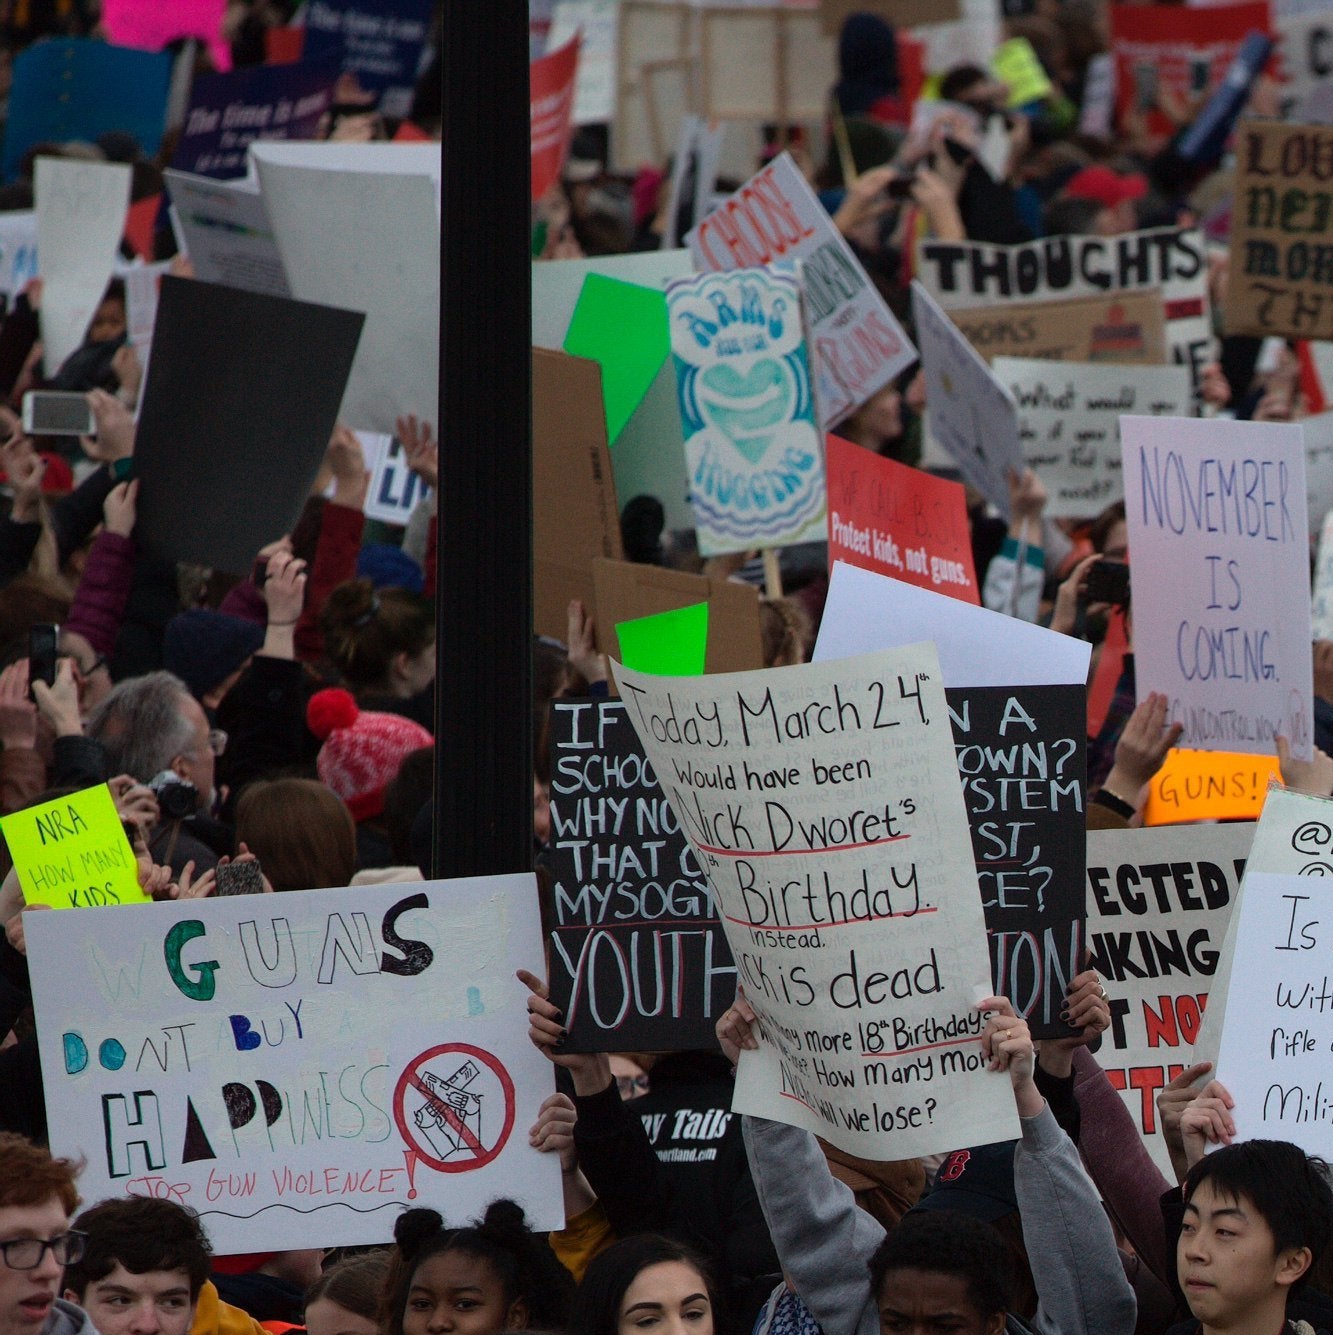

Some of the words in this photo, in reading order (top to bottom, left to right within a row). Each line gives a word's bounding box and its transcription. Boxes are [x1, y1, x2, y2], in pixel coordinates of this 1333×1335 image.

[924, 229, 1203, 296] THOUGHTS
[679, 284, 786, 347] ARMS
[1138, 448, 1296, 543] NOVEMBER
[832, 511, 871, 557] Protect
[873, 529, 903, 572] kids,
[905, 547, 929, 575] not
[931, 556, 970, 586] guns.
[1204, 556, 1242, 612] IS
[1177, 620, 1280, 682] COMING.
[554, 700, 625, 749] IF
[622, 681, 729, 749] Today,
[737, 686, 863, 746] March
[999, 697, 1037, 736] A
[675, 761, 736, 793] Would
[746, 769, 800, 790] have
[812, 757, 872, 785] been
[1159, 770, 1258, 808] GUNS!
[37, 805, 89, 845] NRA
[550, 796, 628, 837] WHY
[765, 798, 916, 851] Dworet's
[29, 861, 75, 890] HOW
[81, 846, 129, 875] MANY
[556, 840, 666, 882] THAT
[68, 882, 122, 907] KIDS
[735, 861, 930, 927] Birthday.
[164, 893, 434, 1001] GUNS
[1275, 896, 1317, 951] Is
[779, 963, 817, 1005] is
[830, 948, 945, 1008] dead.
[62, 1023, 195, 1075] DON'T
[229, 999, 303, 1052] BUY
[804, 1030, 852, 1054] more
[813, 1058, 855, 1087] How
[864, 1055, 932, 1085] many
[101, 1065, 393, 1178] HAPPINESS
[671, 1108, 733, 1140] Tails
[873, 1098, 937, 1132] lose?
[126, 1176, 191, 1202] STOP
[206, 1171, 255, 1201] GUN
[273, 1151, 417, 1200] VIOLENCE!
